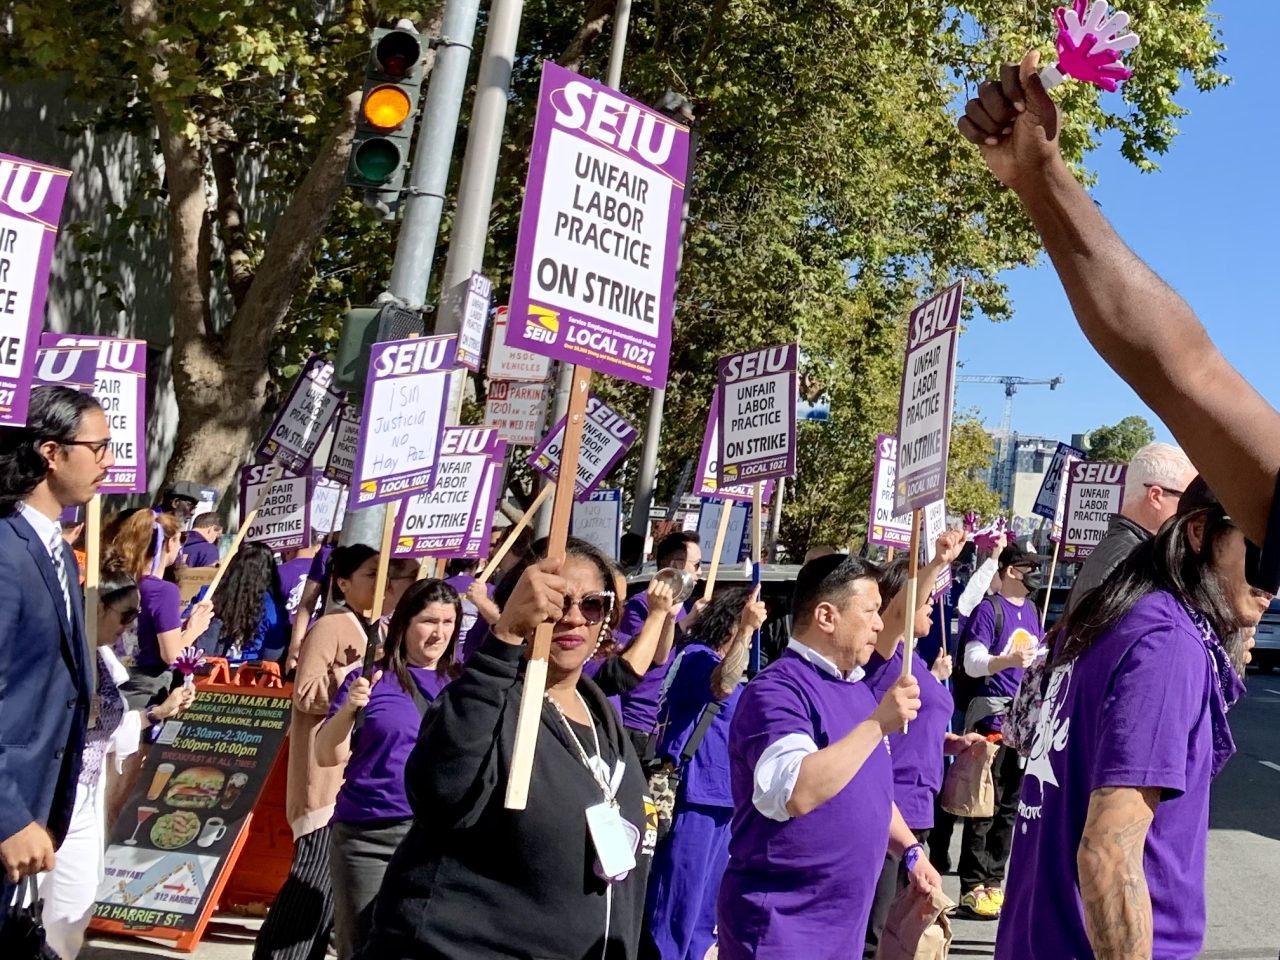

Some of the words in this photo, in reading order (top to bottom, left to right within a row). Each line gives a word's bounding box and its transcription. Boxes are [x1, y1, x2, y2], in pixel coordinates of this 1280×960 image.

[554, 80, 676, 166] SEIU
[574, 152, 649, 205] UNFAIR
[572, 184, 645, 234] LABOR
[554, 211, 652, 270] PRACTICE
[471, 273, 492, 299] SEIU
[537, 257, 579, 298] ON
[582, 274, 657, 325] STRIKE
[910, 286, 957, 349] SEIU
[523, 325, 558, 345] SEIU
[565, 325, 619, 356] LOCAL
[622, 342, 656, 367] 1021
[376, 339, 449, 378] SEIU
[508, 351, 536, 361] HSOC
[724, 344, 790, 383] SEIU
[913, 345, 942, 377] UNFAIR
[501, 361, 541, 373] VEHICLES
[490, 382, 508, 399] NO
[509, 386, 547, 401] PARKING
[737, 381, 776, 401] UNFAIR
[911, 370, 938, 401] LABOR
[738, 396, 775, 416] LABOR
[905, 392, 940, 428] PRACTICE
[509, 419, 524, 430] WED
[585, 397, 634, 440] SEIU
[731, 410, 781, 432] PRACTICE
[276, 424, 291, 441] ON
[726, 442, 744, 459] ON
[746, 433, 787, 455] STRIKE
[900, 442, 913, 470] ON
[913, 428, 942, 463] STRIKE
[372, 450, 399, 475] Hay
[741, 463, 768, 476] LOCAL
[769, 459, 787, 471] 1021
[114, 473, 137, 483] 1021
[436, 475, 468, 489] ABOR
[723, 474, 738, 483] SEIU
[1073, 463, 1123, 483] SEIU
[380, 477, 412, 494] LOCAL
[412, 473, 429, 487] 1021
[907, 481, 926, 499] LOCAL
[926, 473, 940, 490] 1021
[357, 491, 377, 504] SEIU
[416, 491, 469, 505] PRACTICE
[1080, 488, 1110, 499] UNFAIR
[876, 507, 889, 521] ON
[1079, 500, 1109, 510] LABOR
[406, 514, 427, 531] ON
[428, 512, 468, 531] STRIKE
[1073, 511, 1111, 522] PRACTICE
[246, 526, 264, 538] ON
[265, 519, 302, 534] STRIKE
[1068, 528, 1082, 540] ON
[394, 543, 414, 554] SEIU
[415, 539, 448, 551] LOCAL
[448, 538, 464, 547] 1021
[194, 691, 239, 704] UESTION
[239, 695, 270, 708] MARK
[270, 698, 292, 710] BAR
[183, 712, 214, 724] SPORTS,
[214, 715, 252, 728] KARAOKE,
[253, 720, 260, 728] &
[260, 720, 285, 730] MORE
[254, 709, 284, 718] DINNER
[180, 725, 263, 744] 11:30am-2:30pm
[171, 737, 258, 757] 5:00pm-10:00pm
[161, 751, 206, 763] BREAKFAST
[206, 756, 218, 764] AT
[218, 757, 233, 767] ALL
[234, 759, 258, 769] TIMES
[116, 869, 146, 880] BRYANT
[153, 892, 169, 901] 312
[169, 894, 200, 905] HARRIET
[110, 906, 165, 924] HARRIET
[164, 913, 182, 927] ST
